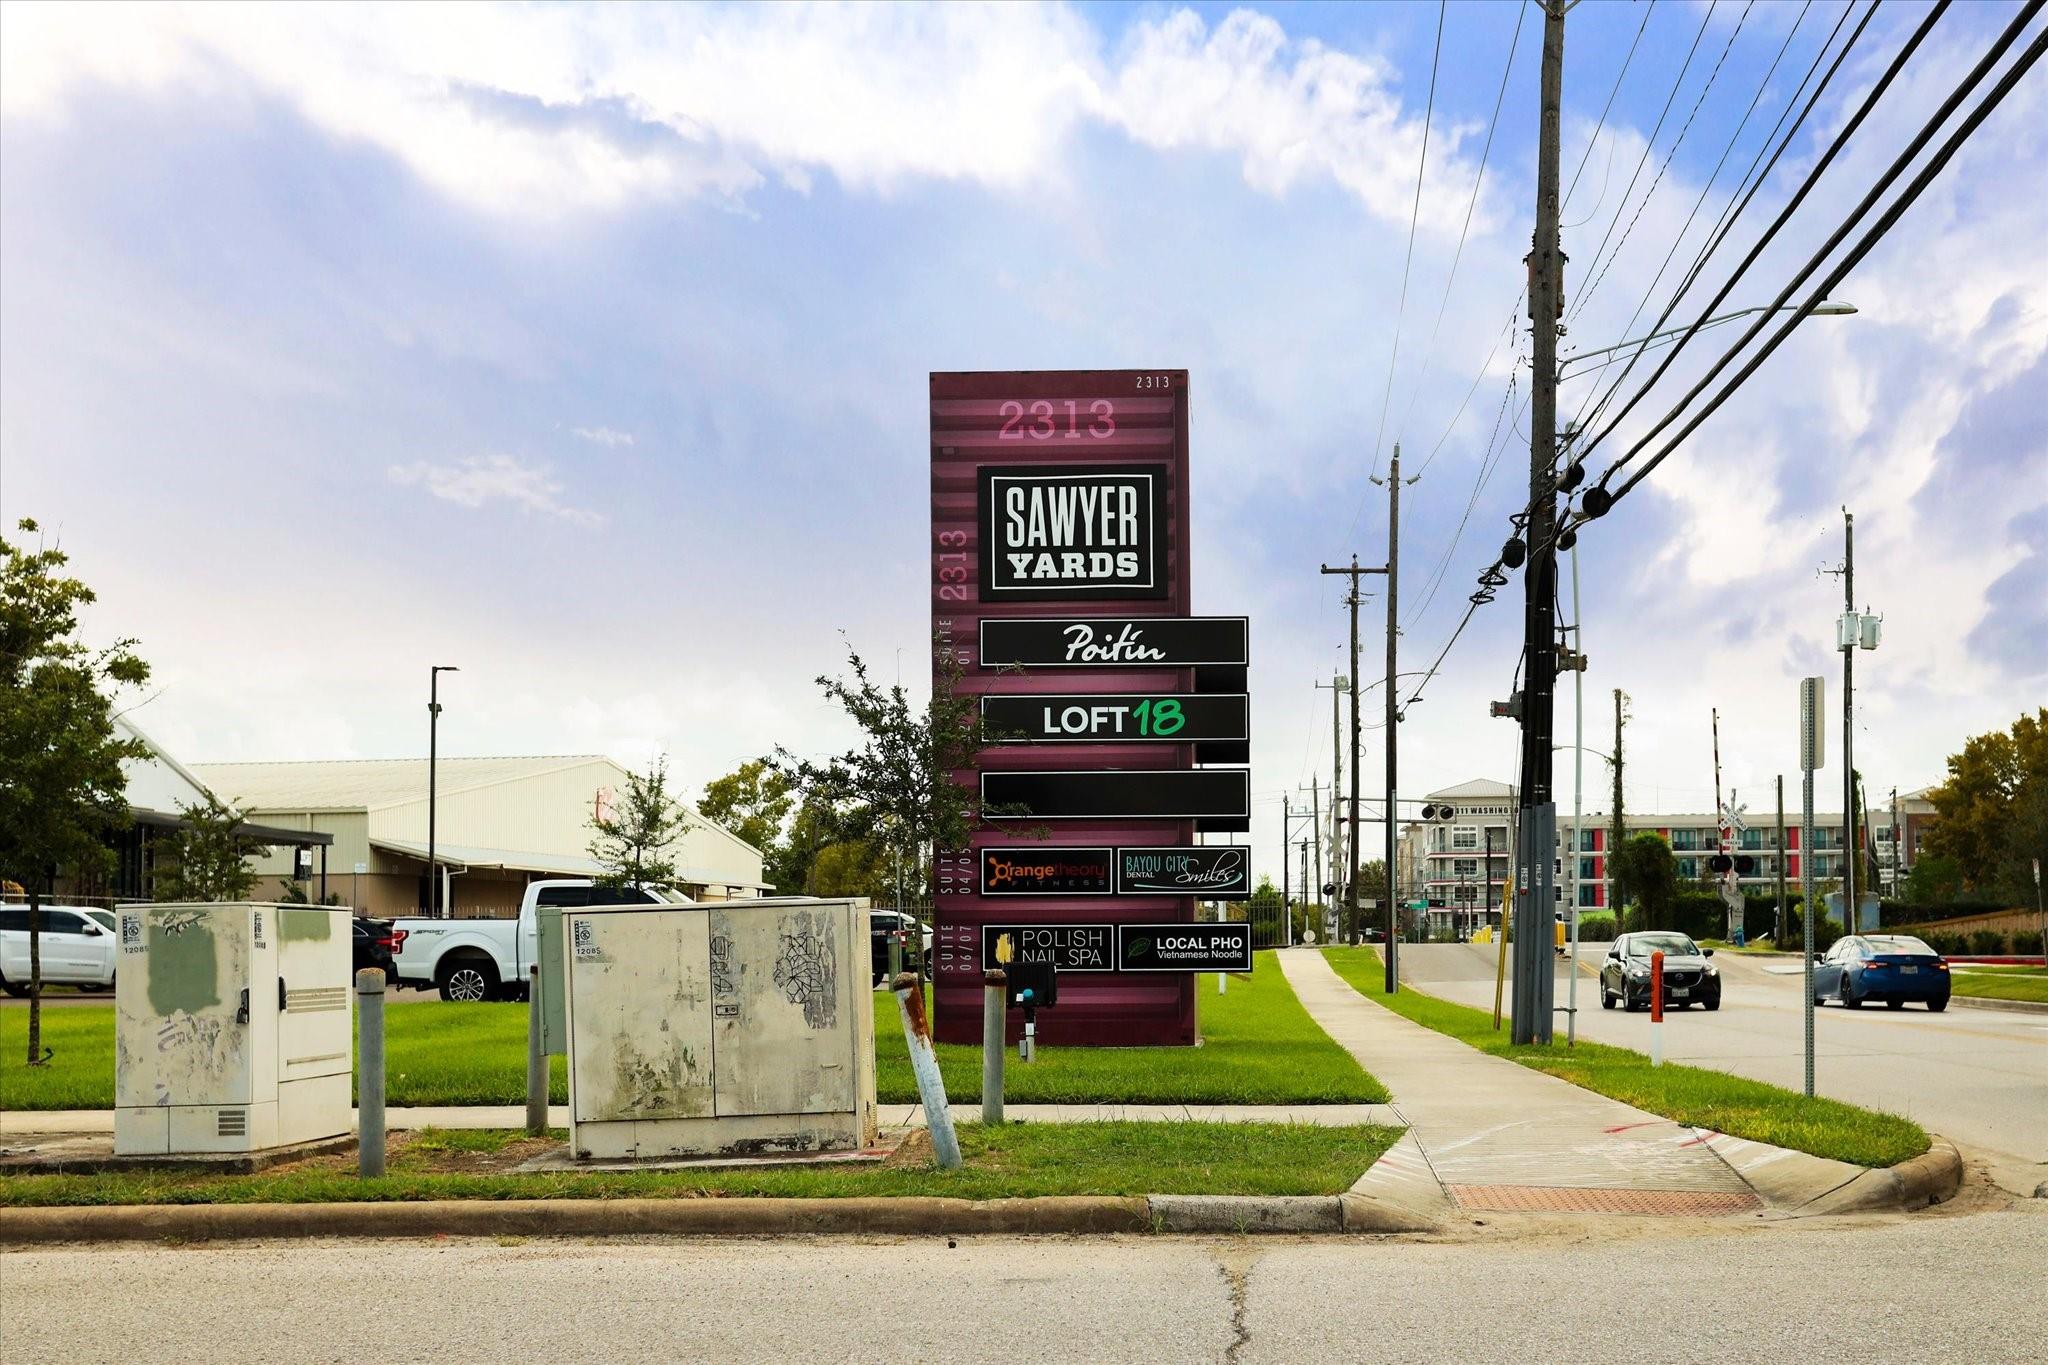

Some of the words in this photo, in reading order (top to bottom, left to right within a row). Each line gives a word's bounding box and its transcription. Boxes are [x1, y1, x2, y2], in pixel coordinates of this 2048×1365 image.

[1136, 376, 1170, 389] 2313
[999, 399, 1116, 440] 2313
[1006, 485, 1138, 548] SAWYER
[939, 529, 968, 601] 2313
[1006, 551, 1139, 579] YARDS
[958, 650, 970, 665] 01
[1043, 706, 1130, 734] LOFT
[1132, 699, 1186, 736] 18
[941, 848, 953, 894] SUITE
[959, 848, 973, 894] 04/05
[1125, 855, 1161, 872] BAYOU
[1165, 855, 1189, 872] CITY
[1175, 850, 1240, 883] Smiles
[941, 925, 954, 971] SUITE
[959, 926, 973, 971] 06/07
[1022, 930, 1103, 947] POLISH
[1156, 937, 1207, 949] LOCAL
[1211, 936, 1243, 949] PHO
[1156, 950, 1209, 959] Vietnamese
[1211, 950, 1243, 959] Noodle
[1022, 949, 1062, 965] NAIL
[1068, 949, 1103, 966] SPA
